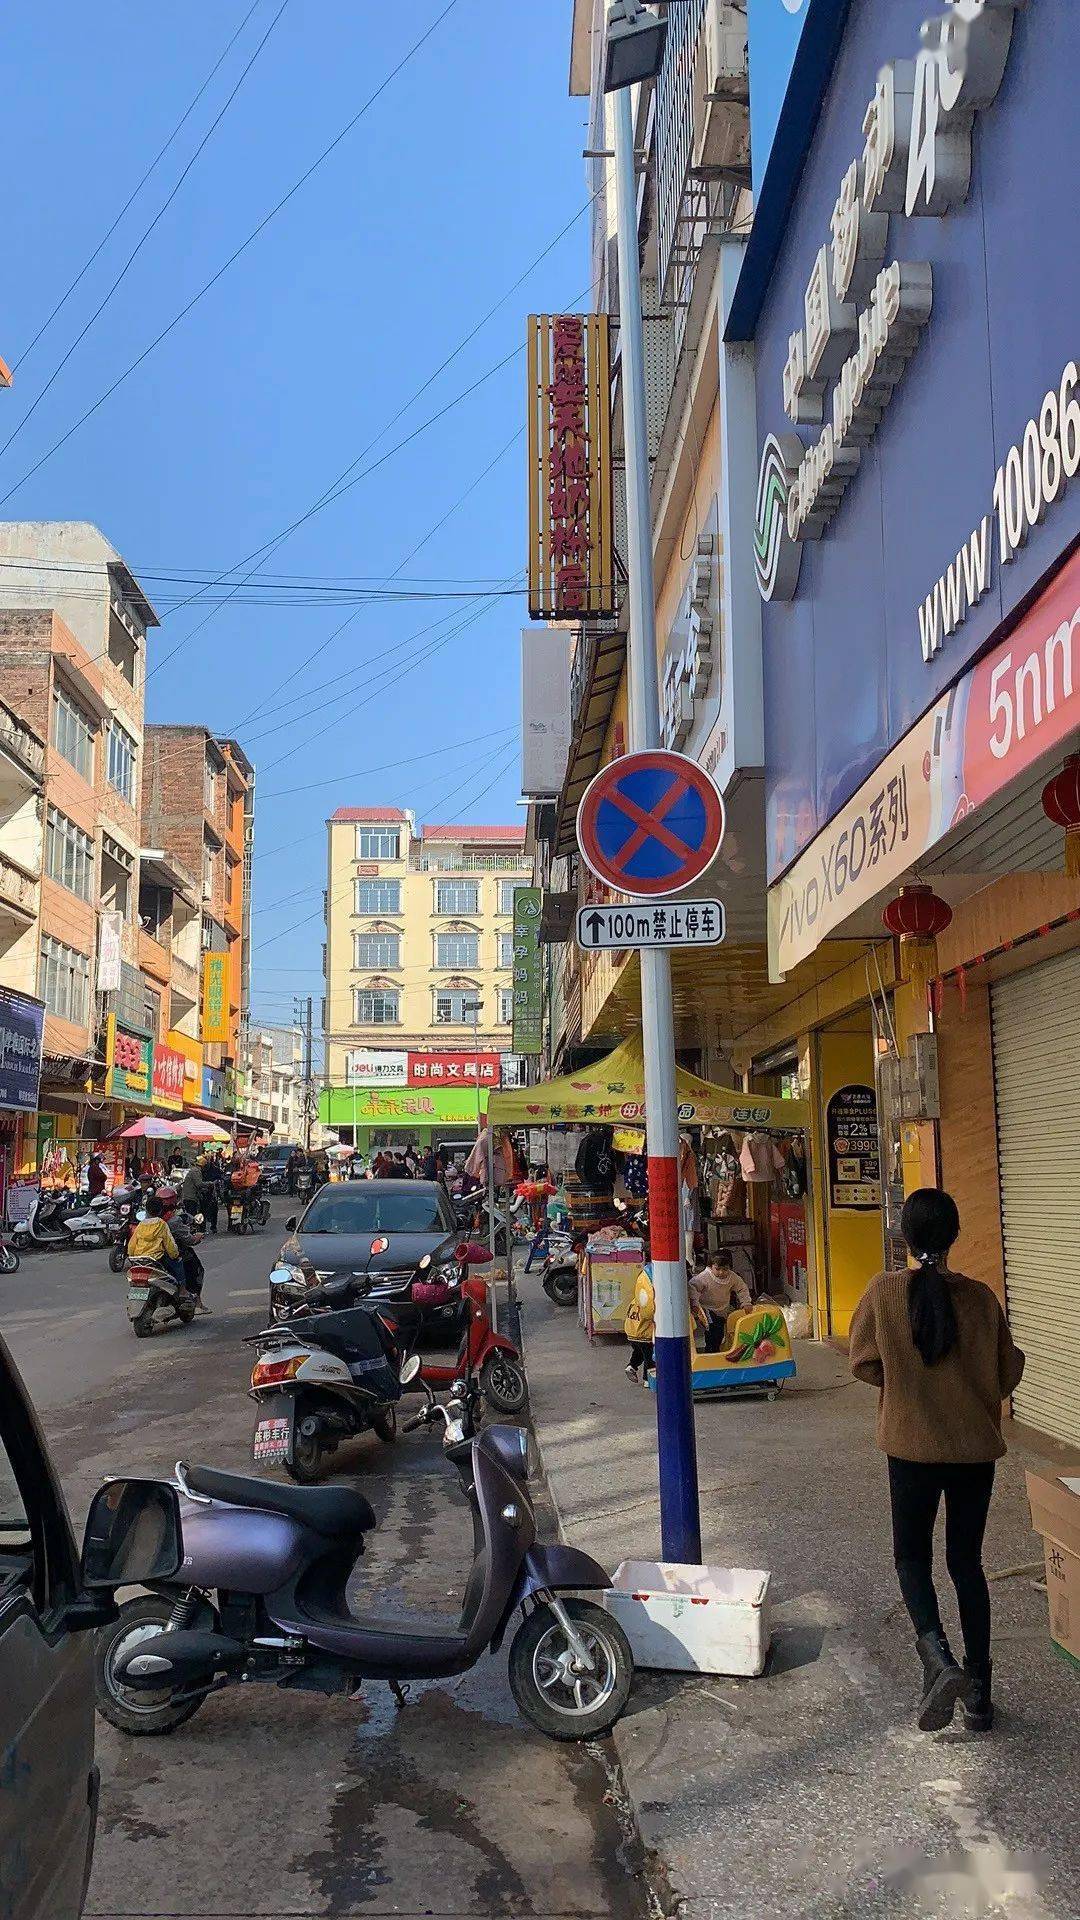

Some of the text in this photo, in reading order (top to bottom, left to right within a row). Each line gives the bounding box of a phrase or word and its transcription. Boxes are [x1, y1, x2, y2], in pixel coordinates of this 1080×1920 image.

[993, 361, 1080, 565] 10086
[413, 1062, 495, 1078] 时尚文具店
